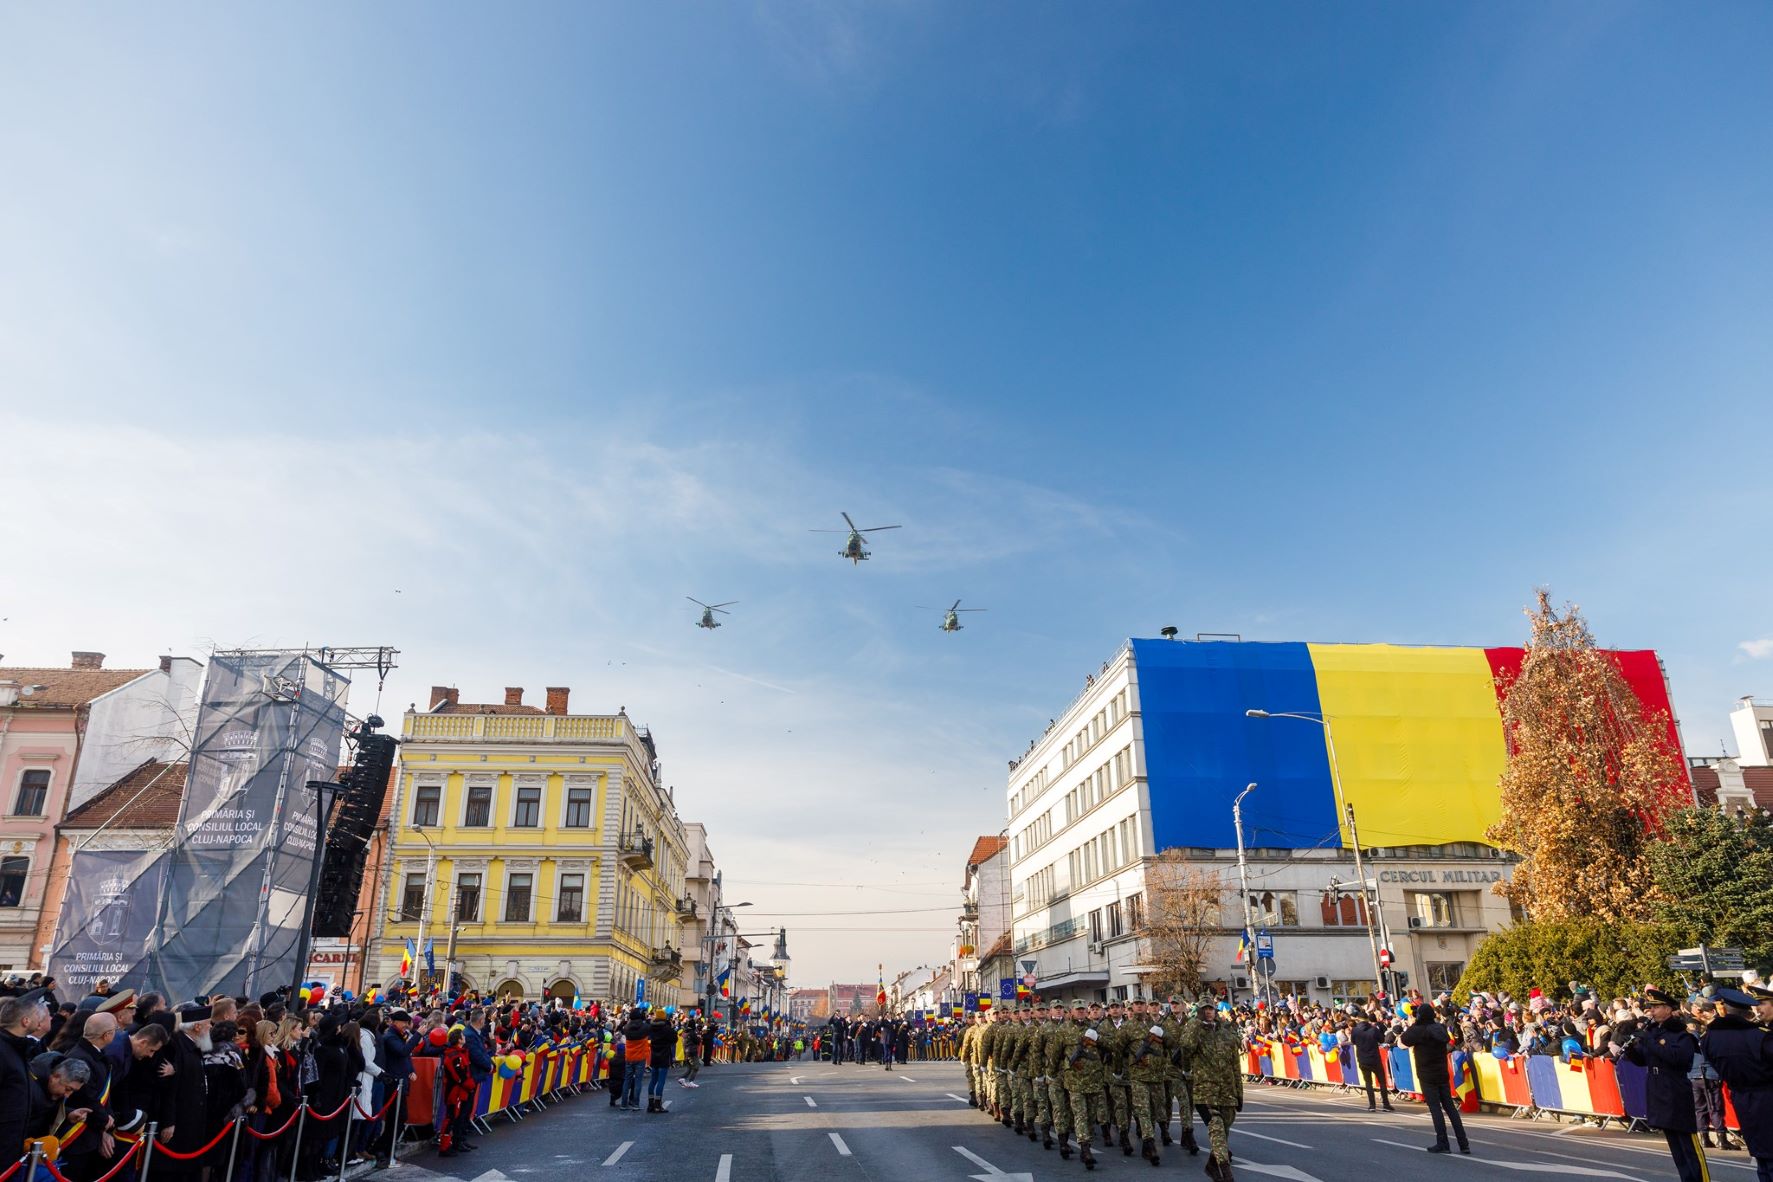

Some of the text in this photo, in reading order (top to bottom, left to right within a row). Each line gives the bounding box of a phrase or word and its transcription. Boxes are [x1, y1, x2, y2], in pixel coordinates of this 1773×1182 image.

[187, 822, 263, 832] CONSILIUL LOCAL
[192, 835, 253, 844] CLUJ-NAPOCA
[1380, 871, 1500, 883] CERCUL MILITAR
[63, 964, 129, 973] CONSILIUL LOCAL
